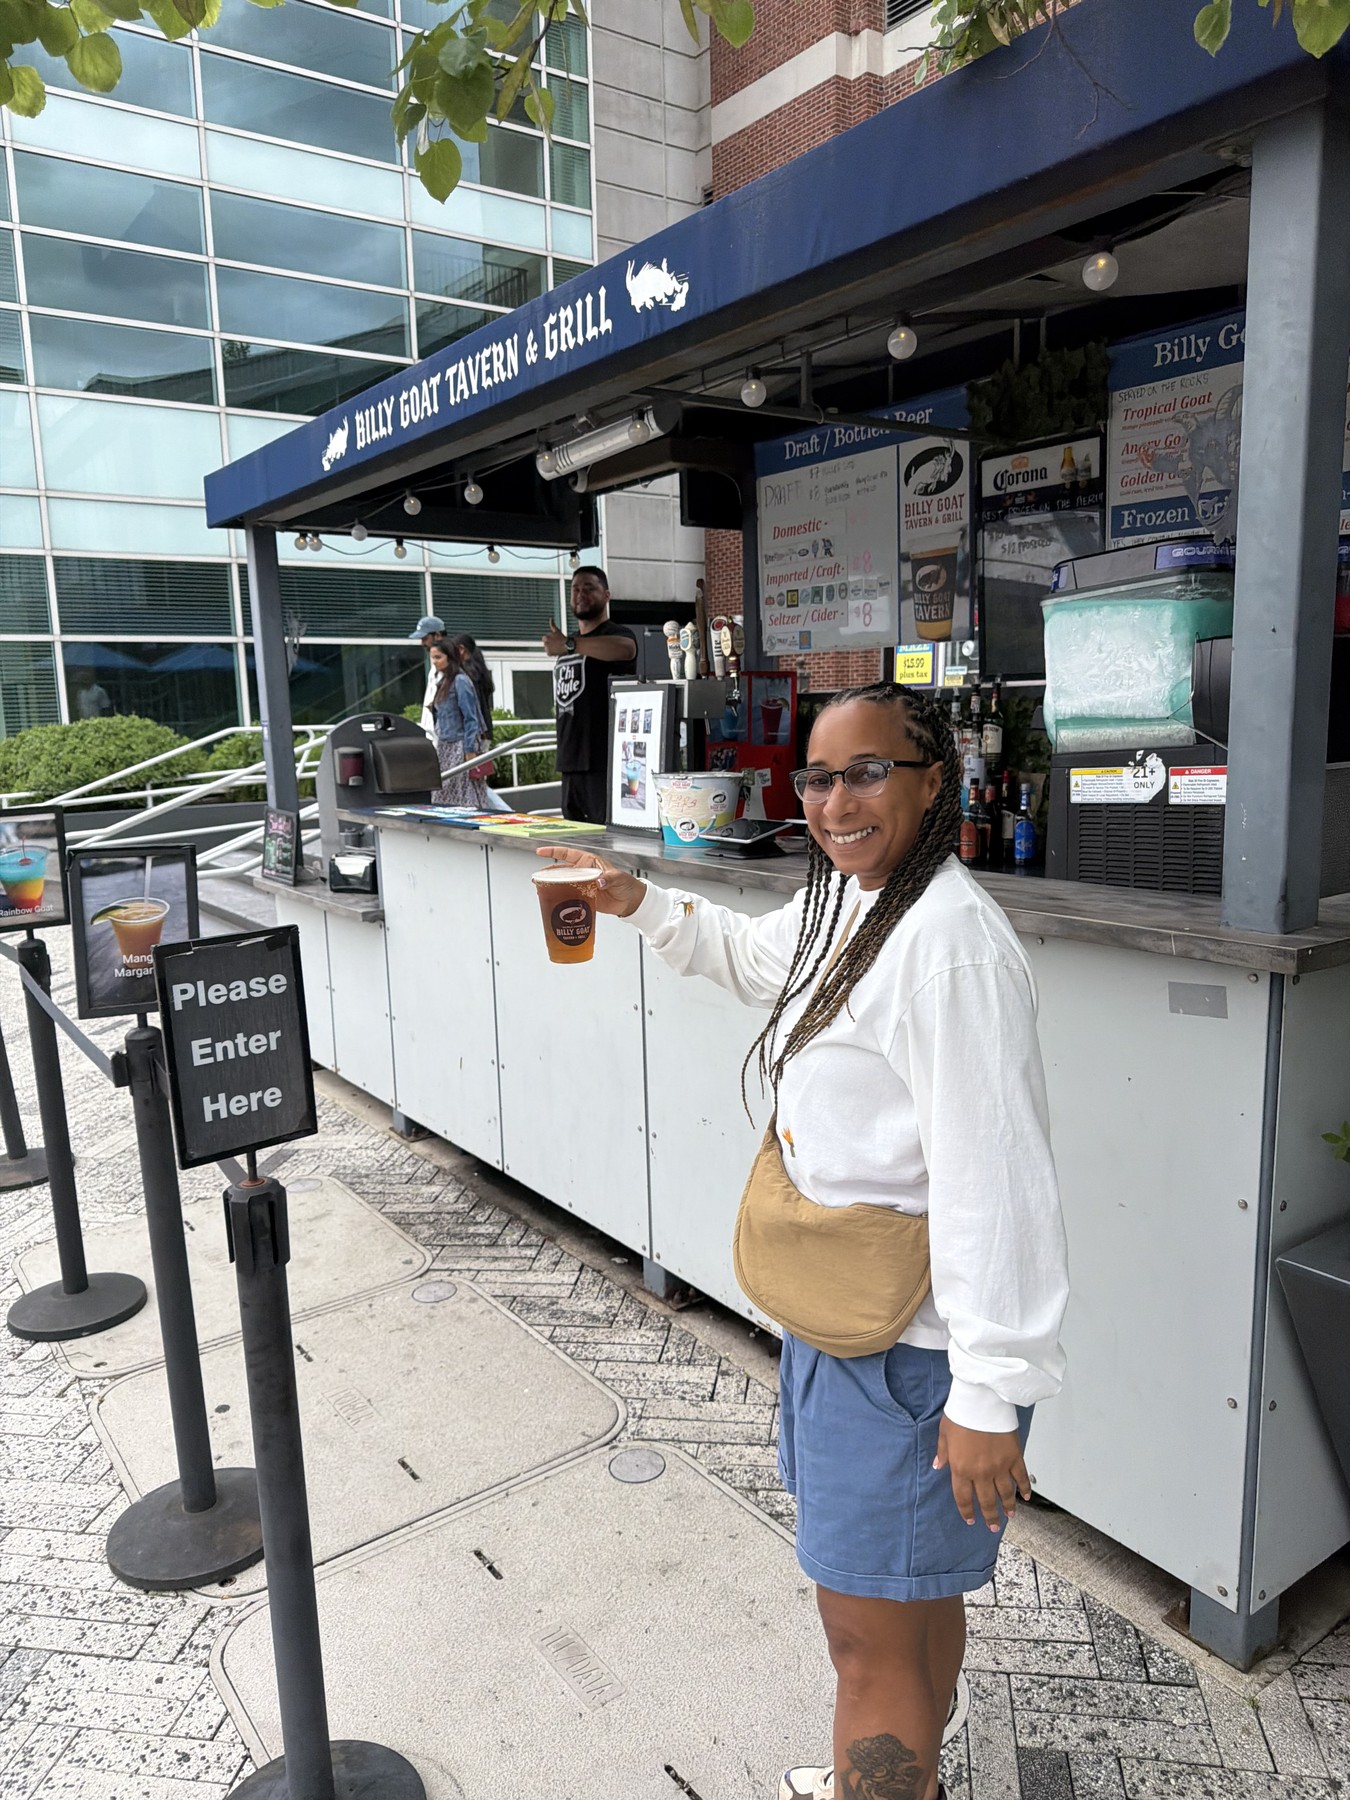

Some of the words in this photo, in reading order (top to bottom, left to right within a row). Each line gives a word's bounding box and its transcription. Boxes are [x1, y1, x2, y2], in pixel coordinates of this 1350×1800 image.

[1153, 333, 1211, 368] Billy
[355, 394, 395, 450] BILLY
[399, 371, 441, 430] GOAT
[445, 332, 519, 406] TAVERN
[525, 328, 539, 363] &
[543, 284, 612, 360] GRILL
[1123, 397, 1177, 421] Tropical
[1181, 391, 1212, 410] Goat
[784, 433, 821, 460] Draft
[1164, 433, 1189, 448] Go
[993, 466, 1048, 493] Corona
[1120, 471, 1164, 488] Golden
[905, 498, 933, 519] BILLY
[937, 493, 965, 512] GOAT
[905, 515, 933, 531] TAVERN
[942, 510, 963, 525] GRILL
[1120, 506, 1190, 530] Frozen
[773, 517, 822, 540] Domestic
[766, 566, 809, 586] Imported
[768, 612, 801, 627] Seltzer
[811, 607, 839, 623] Cider
[903, 656, 925, 669] $15.99
[559, 665, 575, 681] Chi
[899, 671, 914, 681] plus
[916, 670, 928, 679] tax
[556, 679, 580, 700] Style
[1132, 766, 1156, 779] 21+
[1133, 781, 1156, 789] ONLY
[0, 906, 33, 917] Rainbow
[34, 904, 54, 913] Goat
[556, 928, 575, 936] BILLY
[576, 926, 590, 936] GOAT
[122, 954, 153, 965] Mang
[114, 967, 154, 978] Margar
[172, 972, 288, 1012] Please
[190, 1027, 282, 1067] Enter
[202, 1086, 283, 1123] Here
